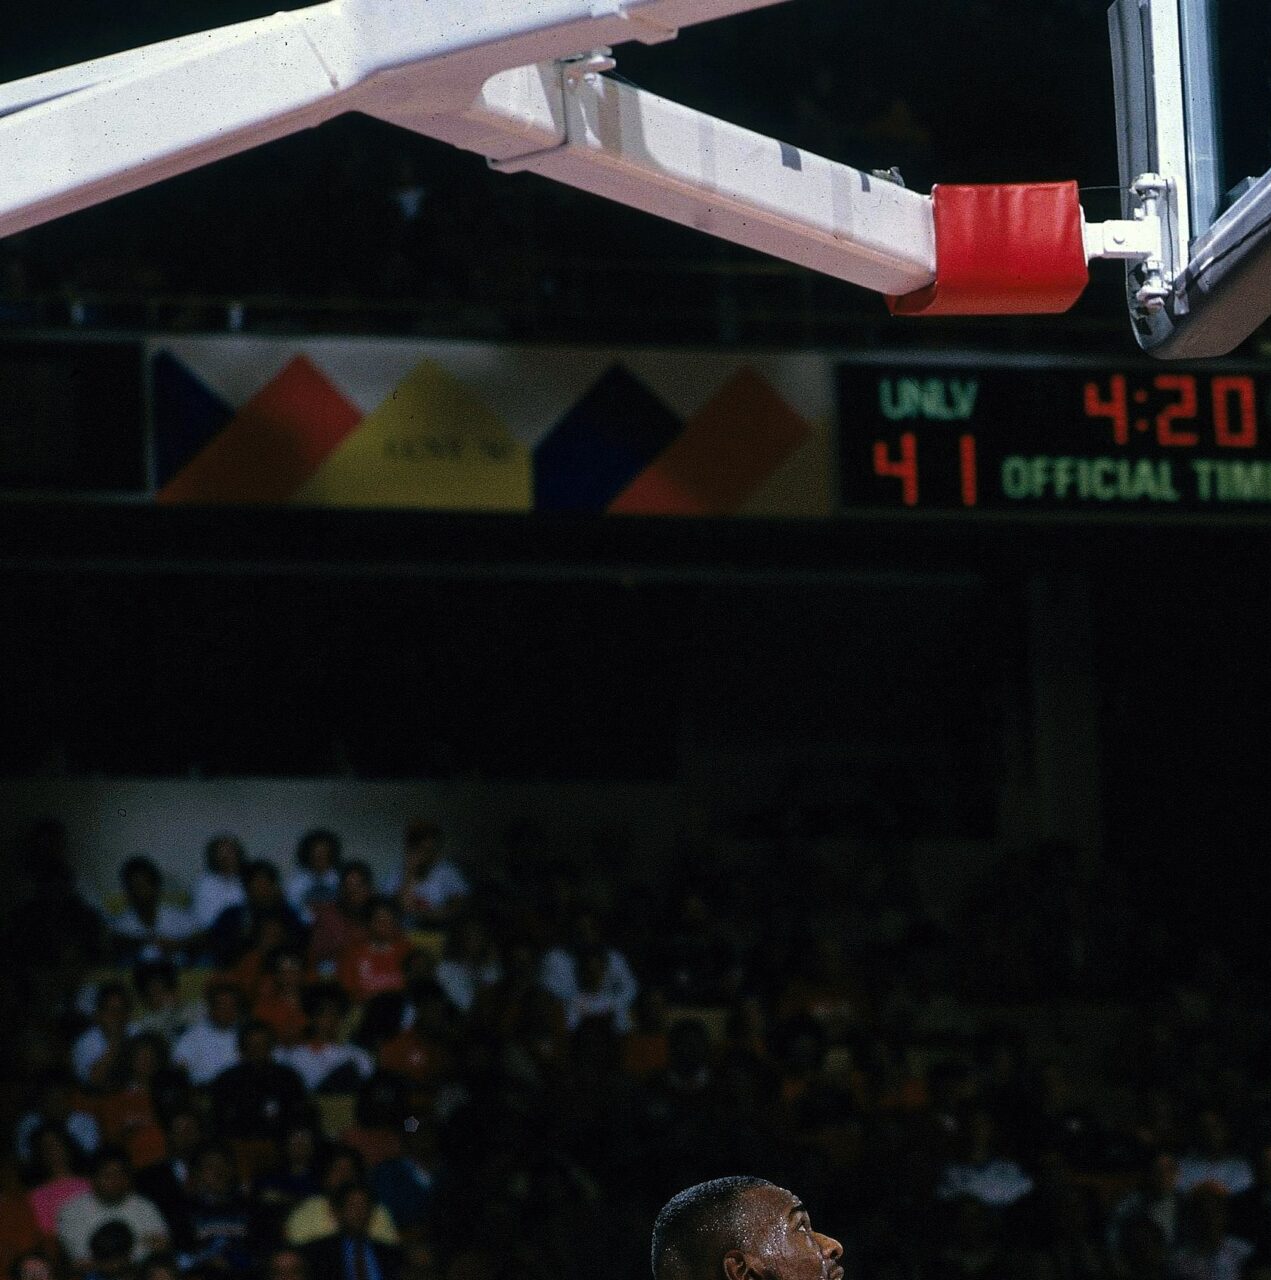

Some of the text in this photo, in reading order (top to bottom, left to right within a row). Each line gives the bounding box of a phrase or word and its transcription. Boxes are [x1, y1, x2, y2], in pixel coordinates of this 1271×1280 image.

[878, 376, 979, 421] UNLV
[1084, 374, 1258, 448] 4:20
[874, 432, 977, 507] 41
[1002, 456, 1179, 500] OFFICIAL
